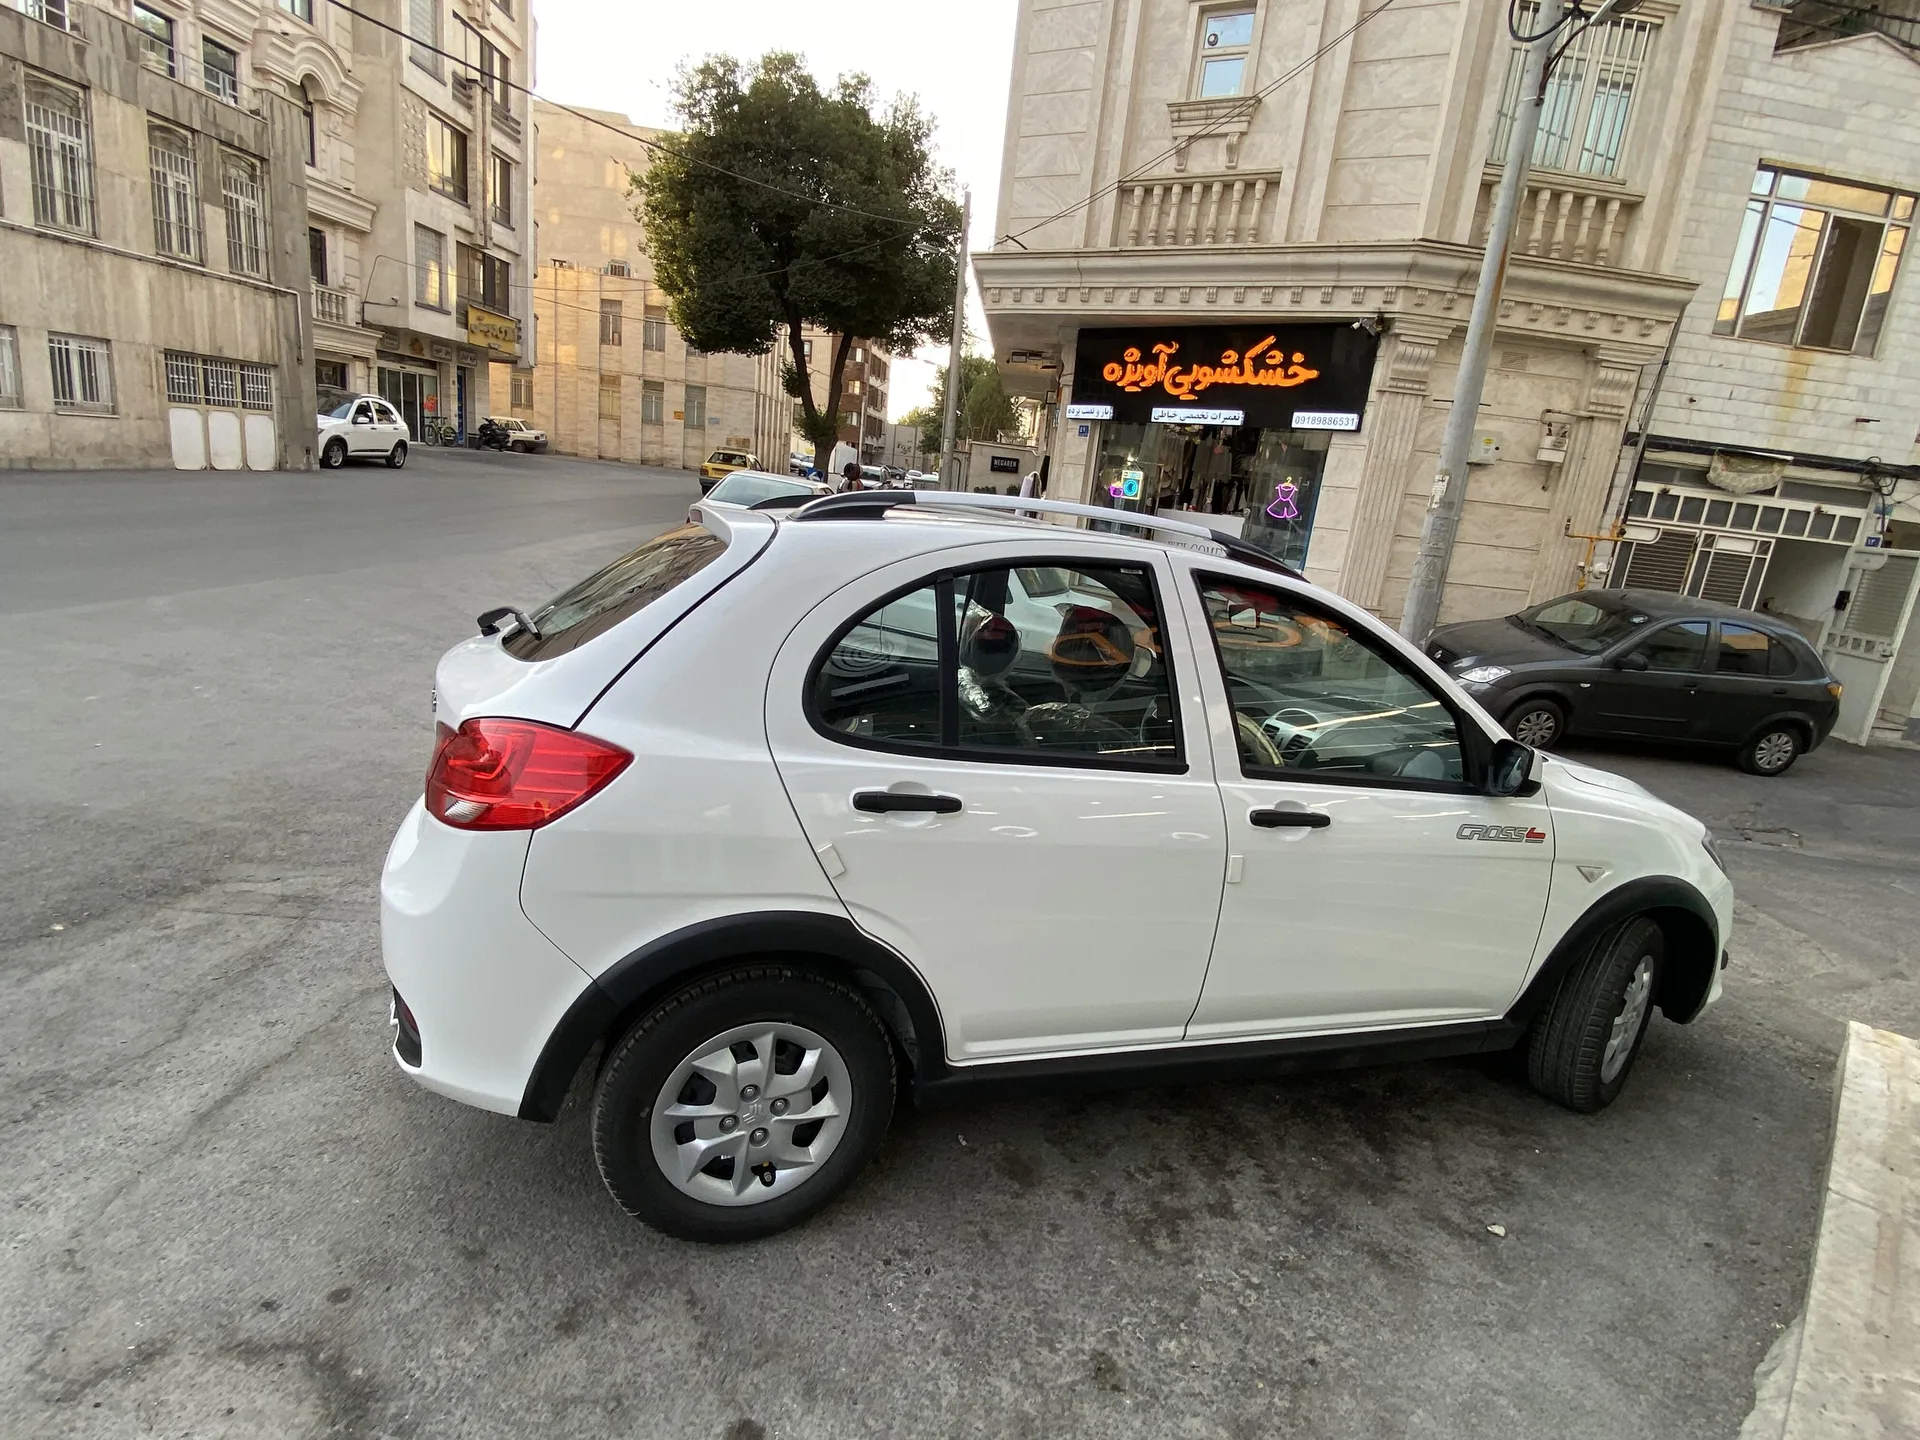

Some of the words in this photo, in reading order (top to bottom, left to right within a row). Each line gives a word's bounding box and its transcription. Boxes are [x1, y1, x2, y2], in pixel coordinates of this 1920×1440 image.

[1163, 335, 1319, 400] خشکشویی
[1154, 410, 1177, 420] خیاطی
[1180, 411, 1208, 421] تخصصی
[1211, 412, 1240, 423] تعمیرات
[1294, 415, 1355, 426] 09189886531
[1456, 823, 1528, 842] CROSS
